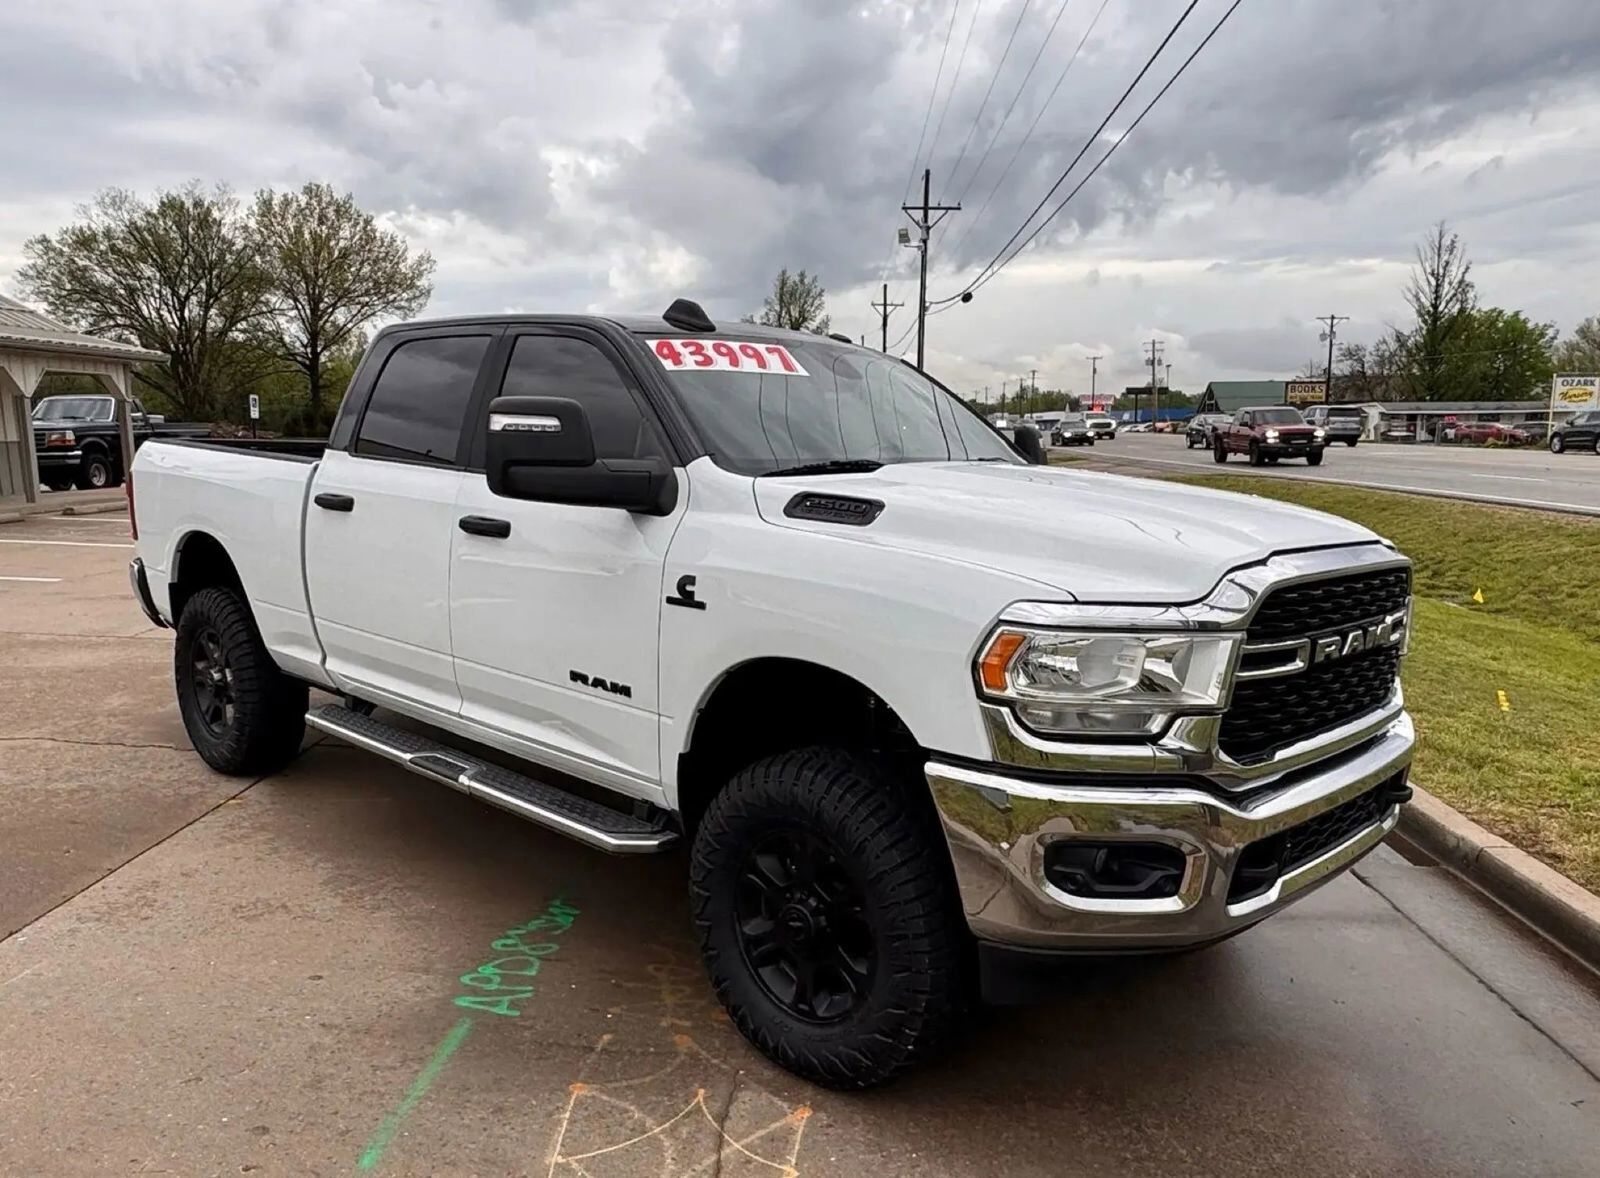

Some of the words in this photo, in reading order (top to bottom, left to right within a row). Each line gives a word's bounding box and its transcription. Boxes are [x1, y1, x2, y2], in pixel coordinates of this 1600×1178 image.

[655, 339, 798, 373] 43997
[1289, 384, 1324, 394] BOOKS
[1561, 378, 1596, 387] OZARK
[805, 497, 867, 513] 2500
[1314, 623, 1392, 663] RAM
[569, 669, 632, 698] RAM
